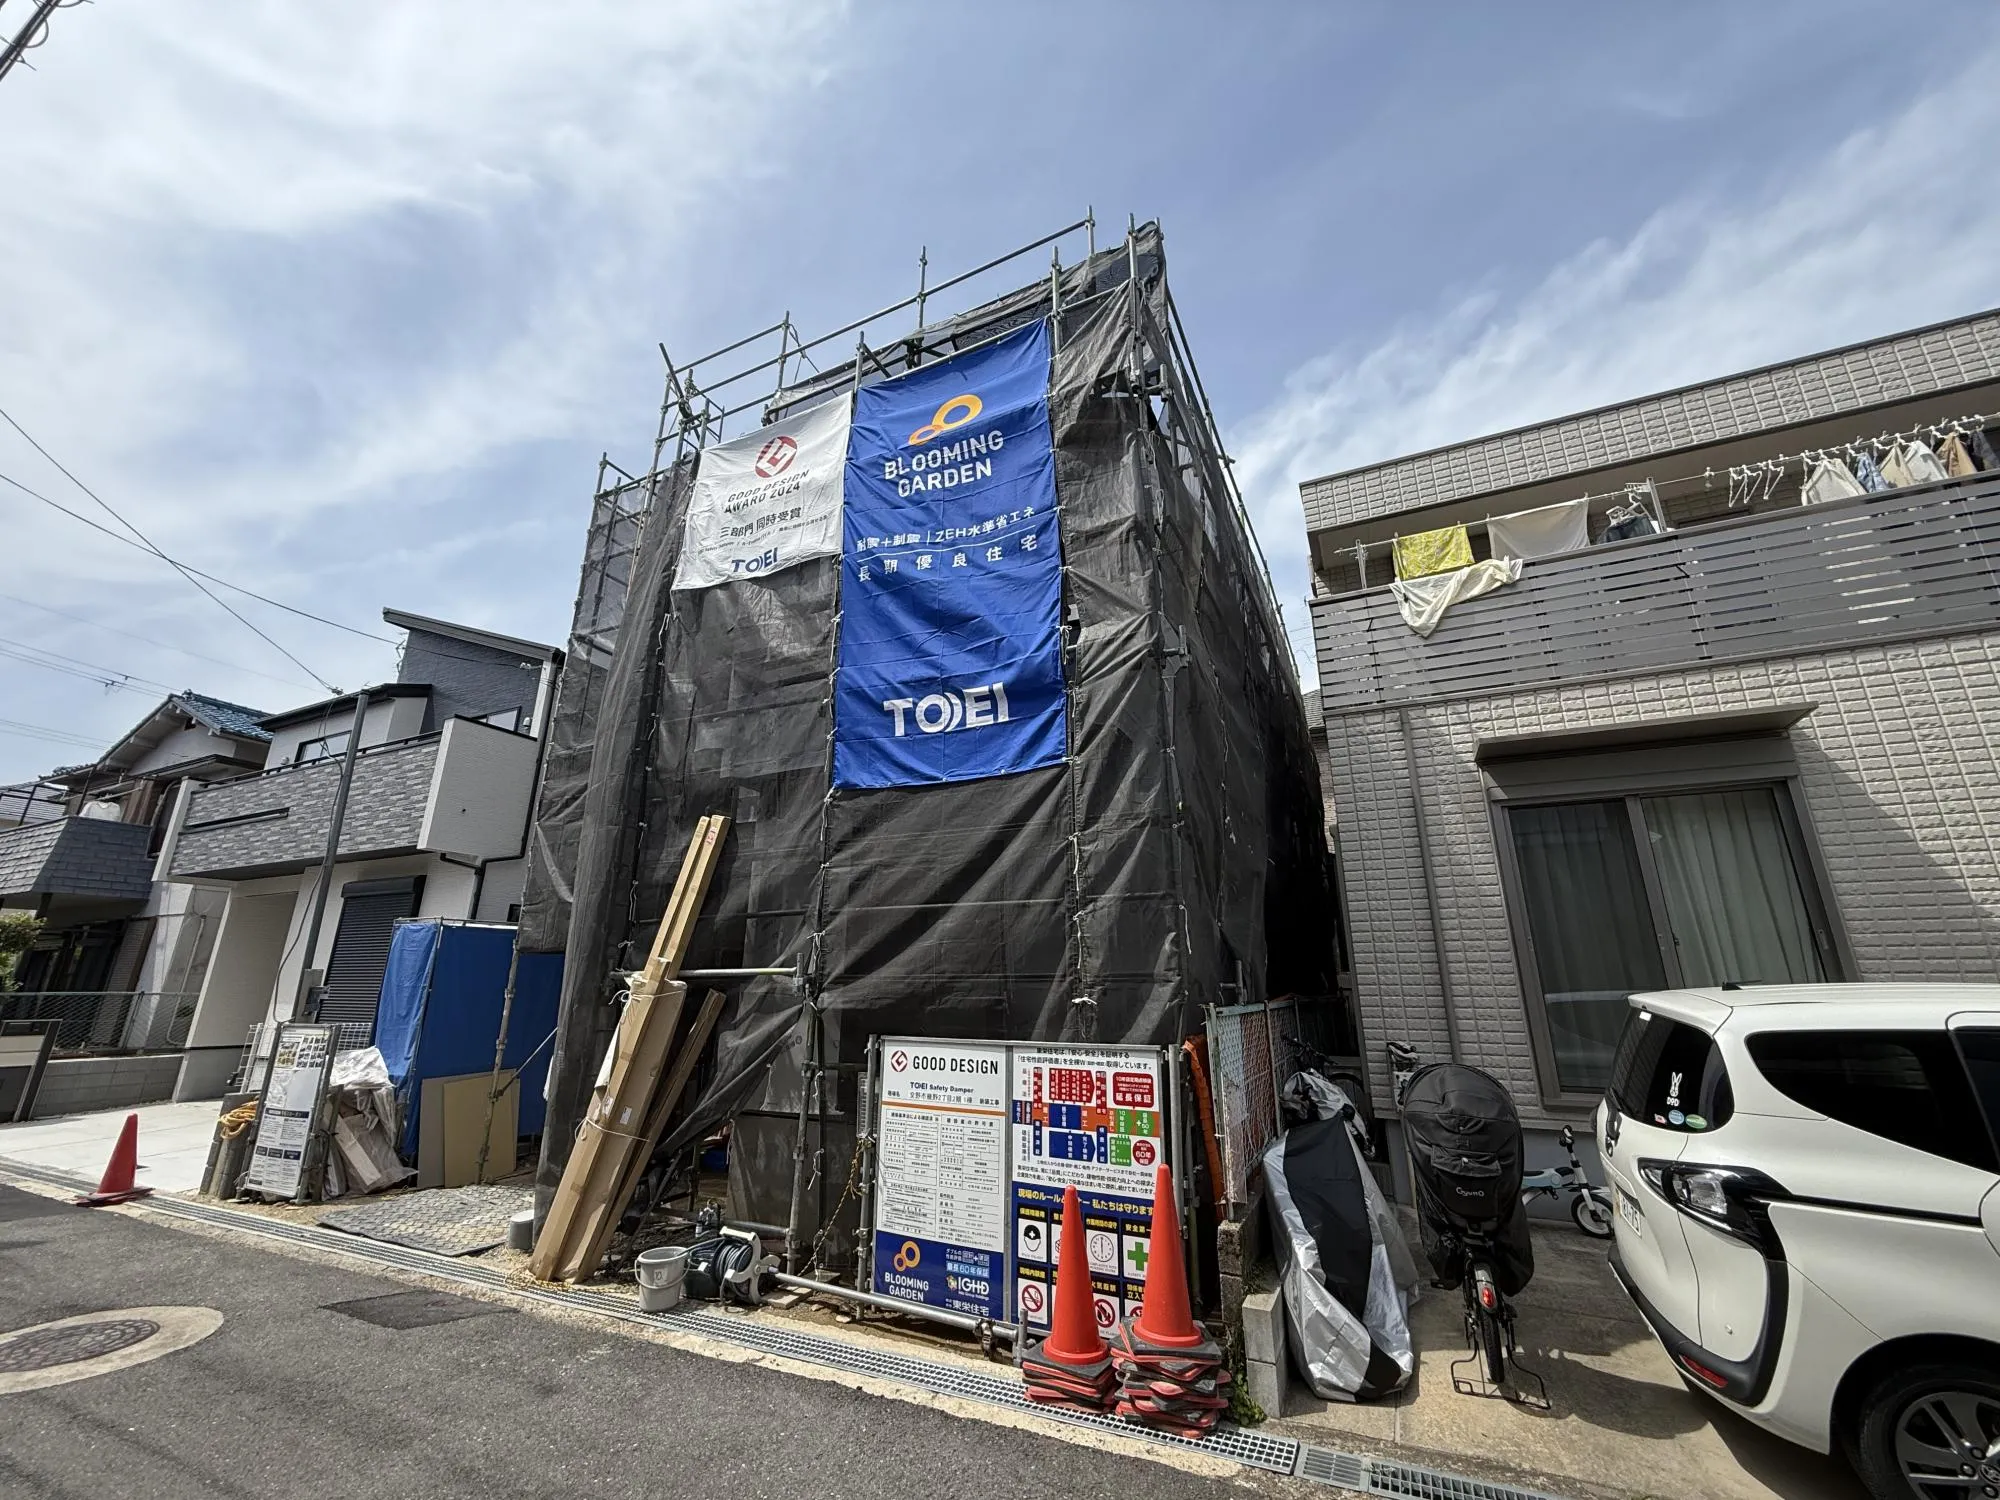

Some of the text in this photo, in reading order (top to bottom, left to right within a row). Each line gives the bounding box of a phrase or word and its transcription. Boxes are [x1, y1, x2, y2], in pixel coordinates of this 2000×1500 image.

[884, 430, 1004, 480] BLOOMING
[728, 469, 810, 503] GOOD DESIGN
[898, 458, 993, 498] GARDEN
[724, 482, 801, 514] AWARD 2024
[719, 522, 754, 539] 三部門
[756, 507, 802, 532] 同時受賞
[935, 506, 1036, 543] ZEH水準省エネ
[731, 547, 779, 573] TOEI
[858, 534, 1038, 583] 長期優良住宅
[883, 682, 1009, 736] TOEI
[913, 1055, 999, 1075] GOOD DESIGN
[910, 1081, 974, 1094] TOEI Safety Damper
[1125, 1223, 1152, 1233] 安全第一
[884, 1272, 930, 1291] BLOOMING
[889, 1285, 924, 1302] GARDEN
[958, 1277, 990, 1295] IGHD
[952, 1299, 990, 1316] 東栄住宅
